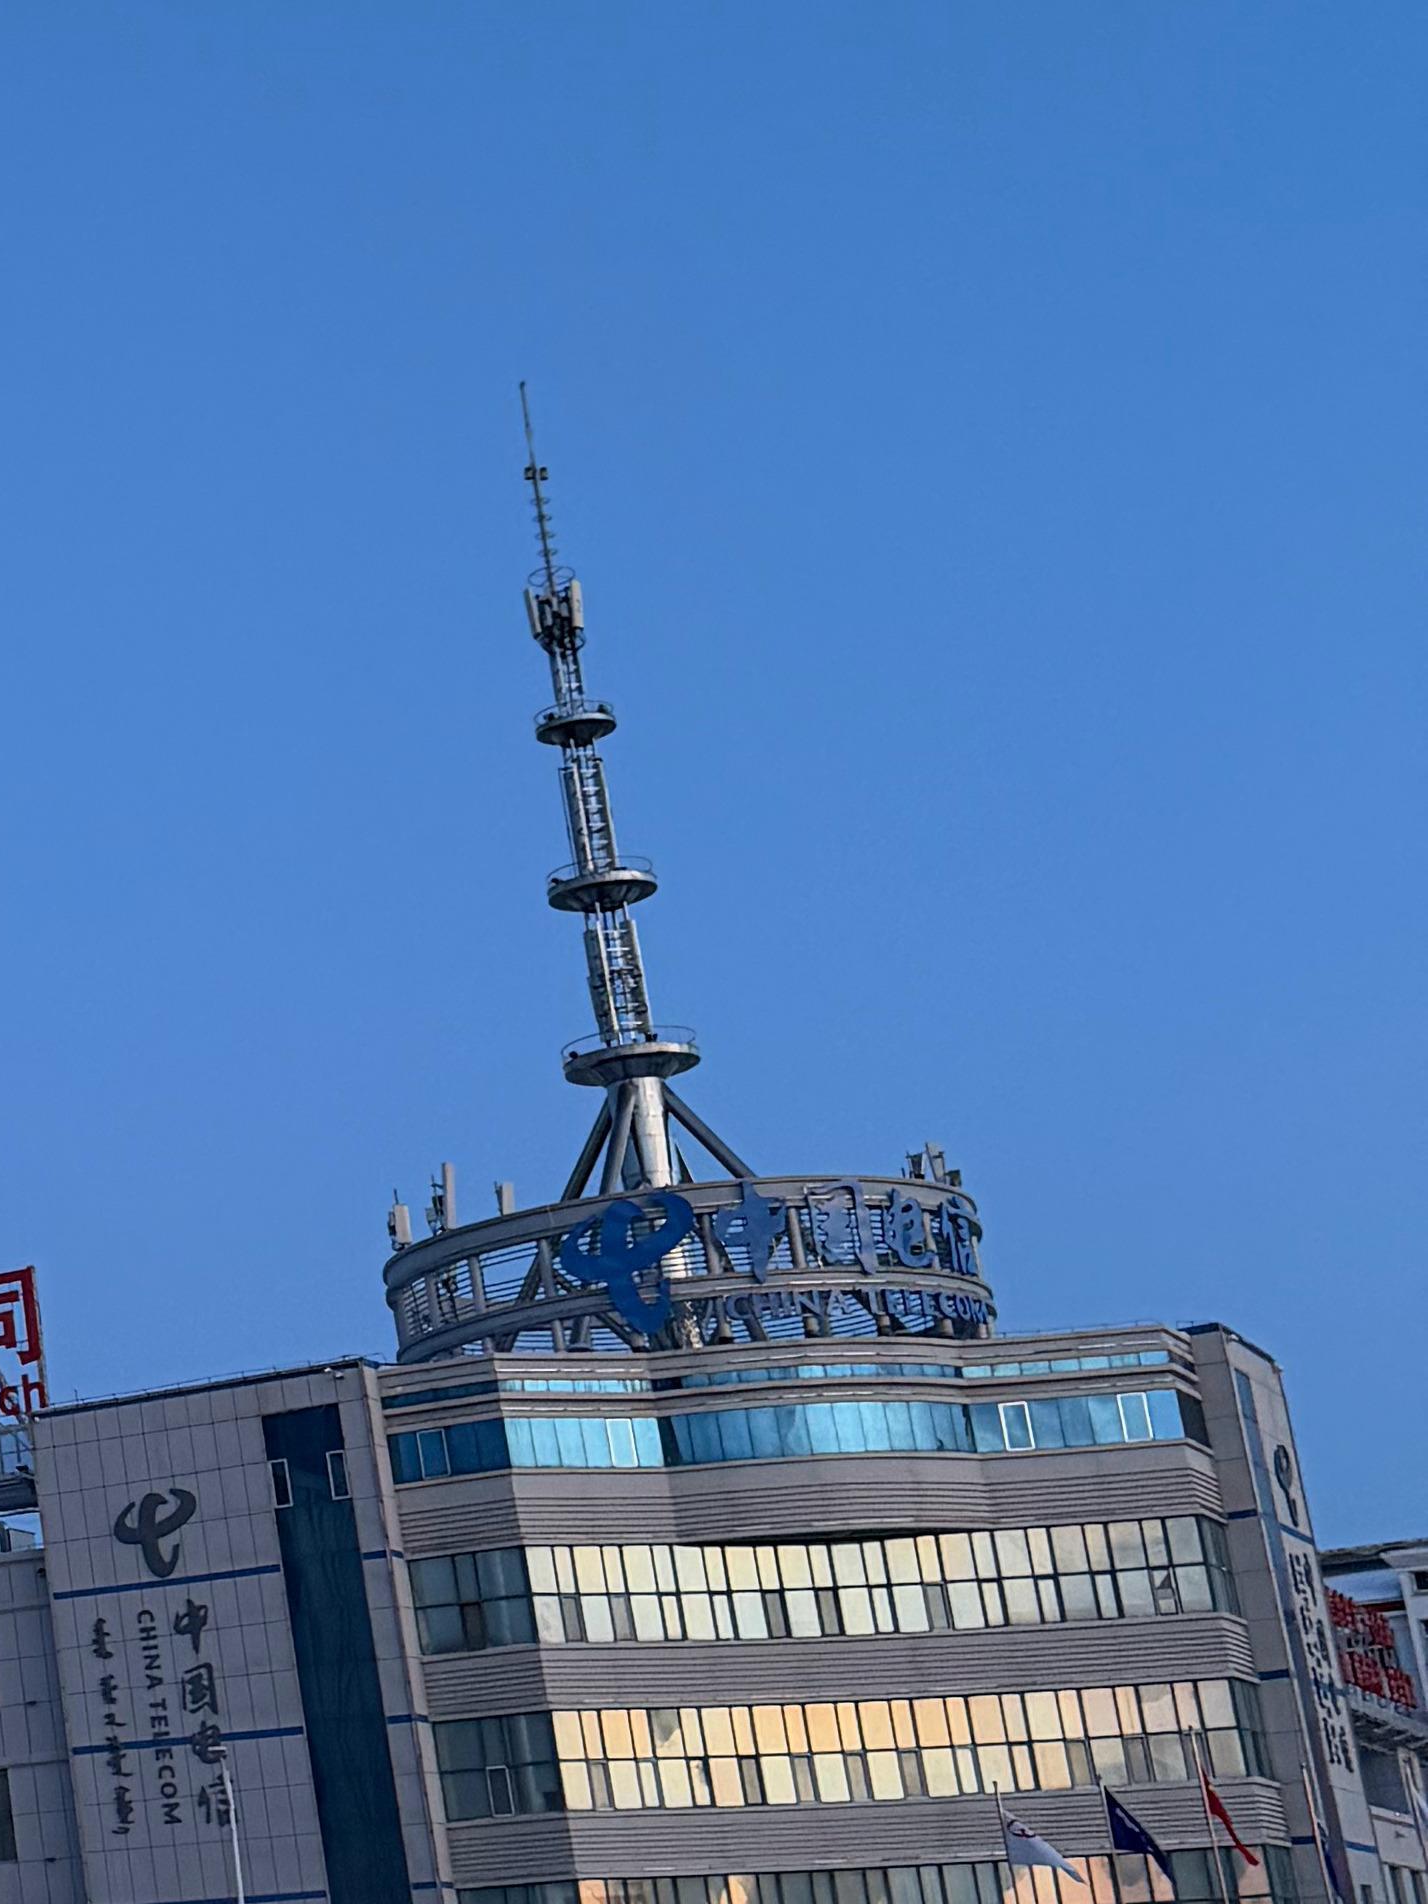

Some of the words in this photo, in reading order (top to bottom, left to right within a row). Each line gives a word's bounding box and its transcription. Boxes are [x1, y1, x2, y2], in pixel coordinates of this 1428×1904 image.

[713, 1178, 984, 1284] 中国电信
[725, 1289, 846, 1323] CHINA
[866, 1288, 989, 1325] TELECOM
[137, 1609, 164, 1690] CHINA
[148, 1698, 182, 1825] TELECOM
